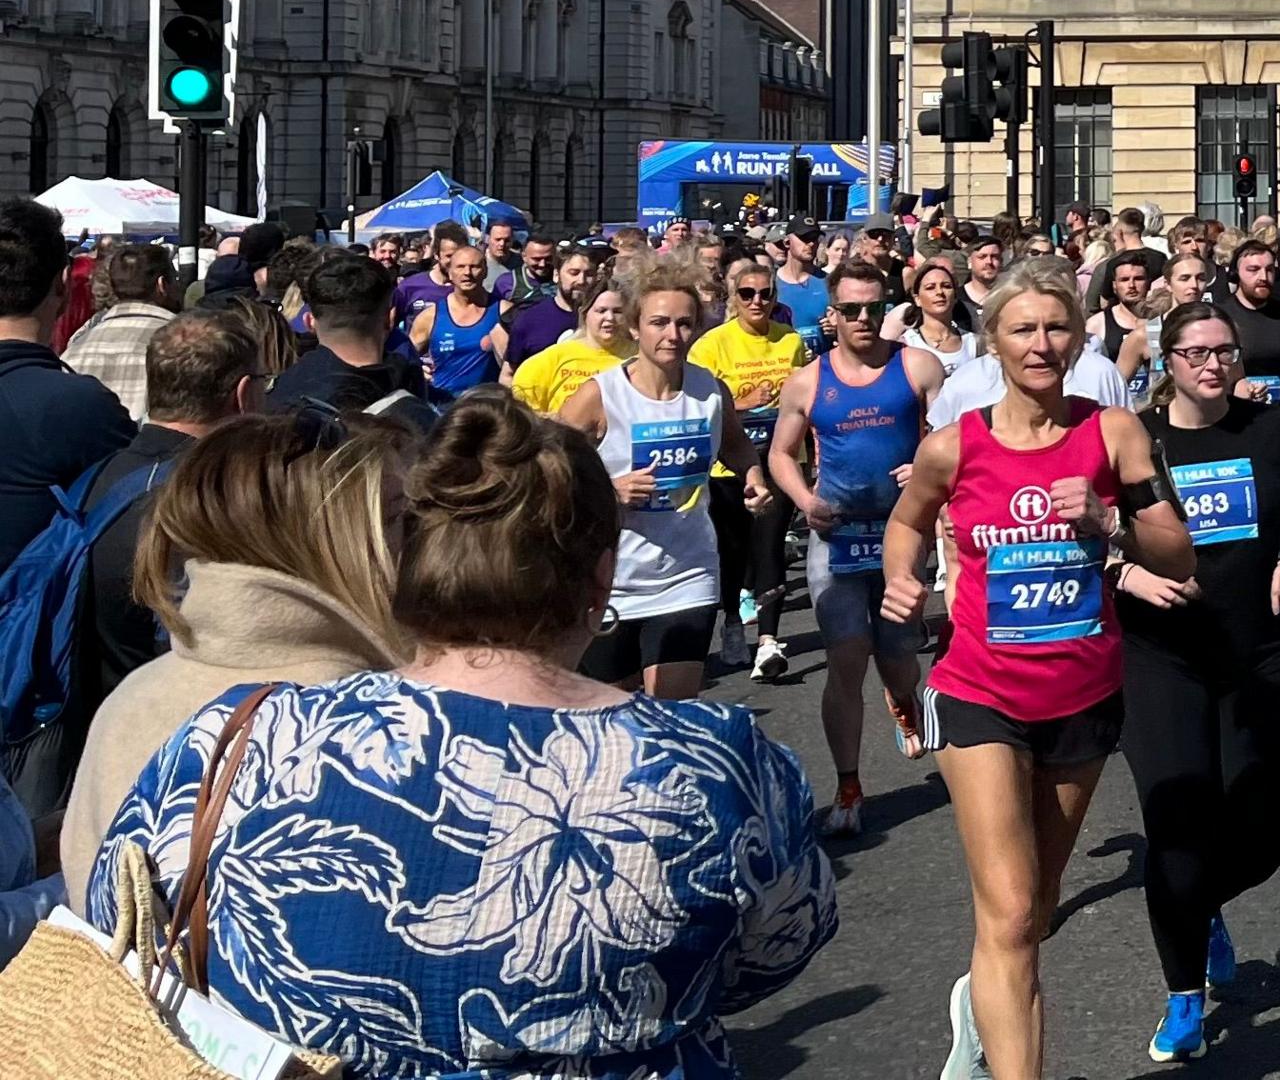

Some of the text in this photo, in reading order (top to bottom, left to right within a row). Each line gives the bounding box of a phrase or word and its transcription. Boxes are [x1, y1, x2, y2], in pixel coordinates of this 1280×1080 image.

[738, 152, 760, 160] Jane
[737, 162, 773, 175] RUN
[811, 162, 841, 176] ALL
[847, 406, 880, 419] JOLLY
[836, 416, 895, 432] TRIATHLON
[649, 447, 698, 467] 2586
[1184, 466, 1239, 481] HULL 10K
[1183, 492, 1230, 517] 683
[971, 522, 1076, 549] fitmum
[1027, 550, 1088, 564] HULL 10K
[1010, 579, 1080, 610] 2749
